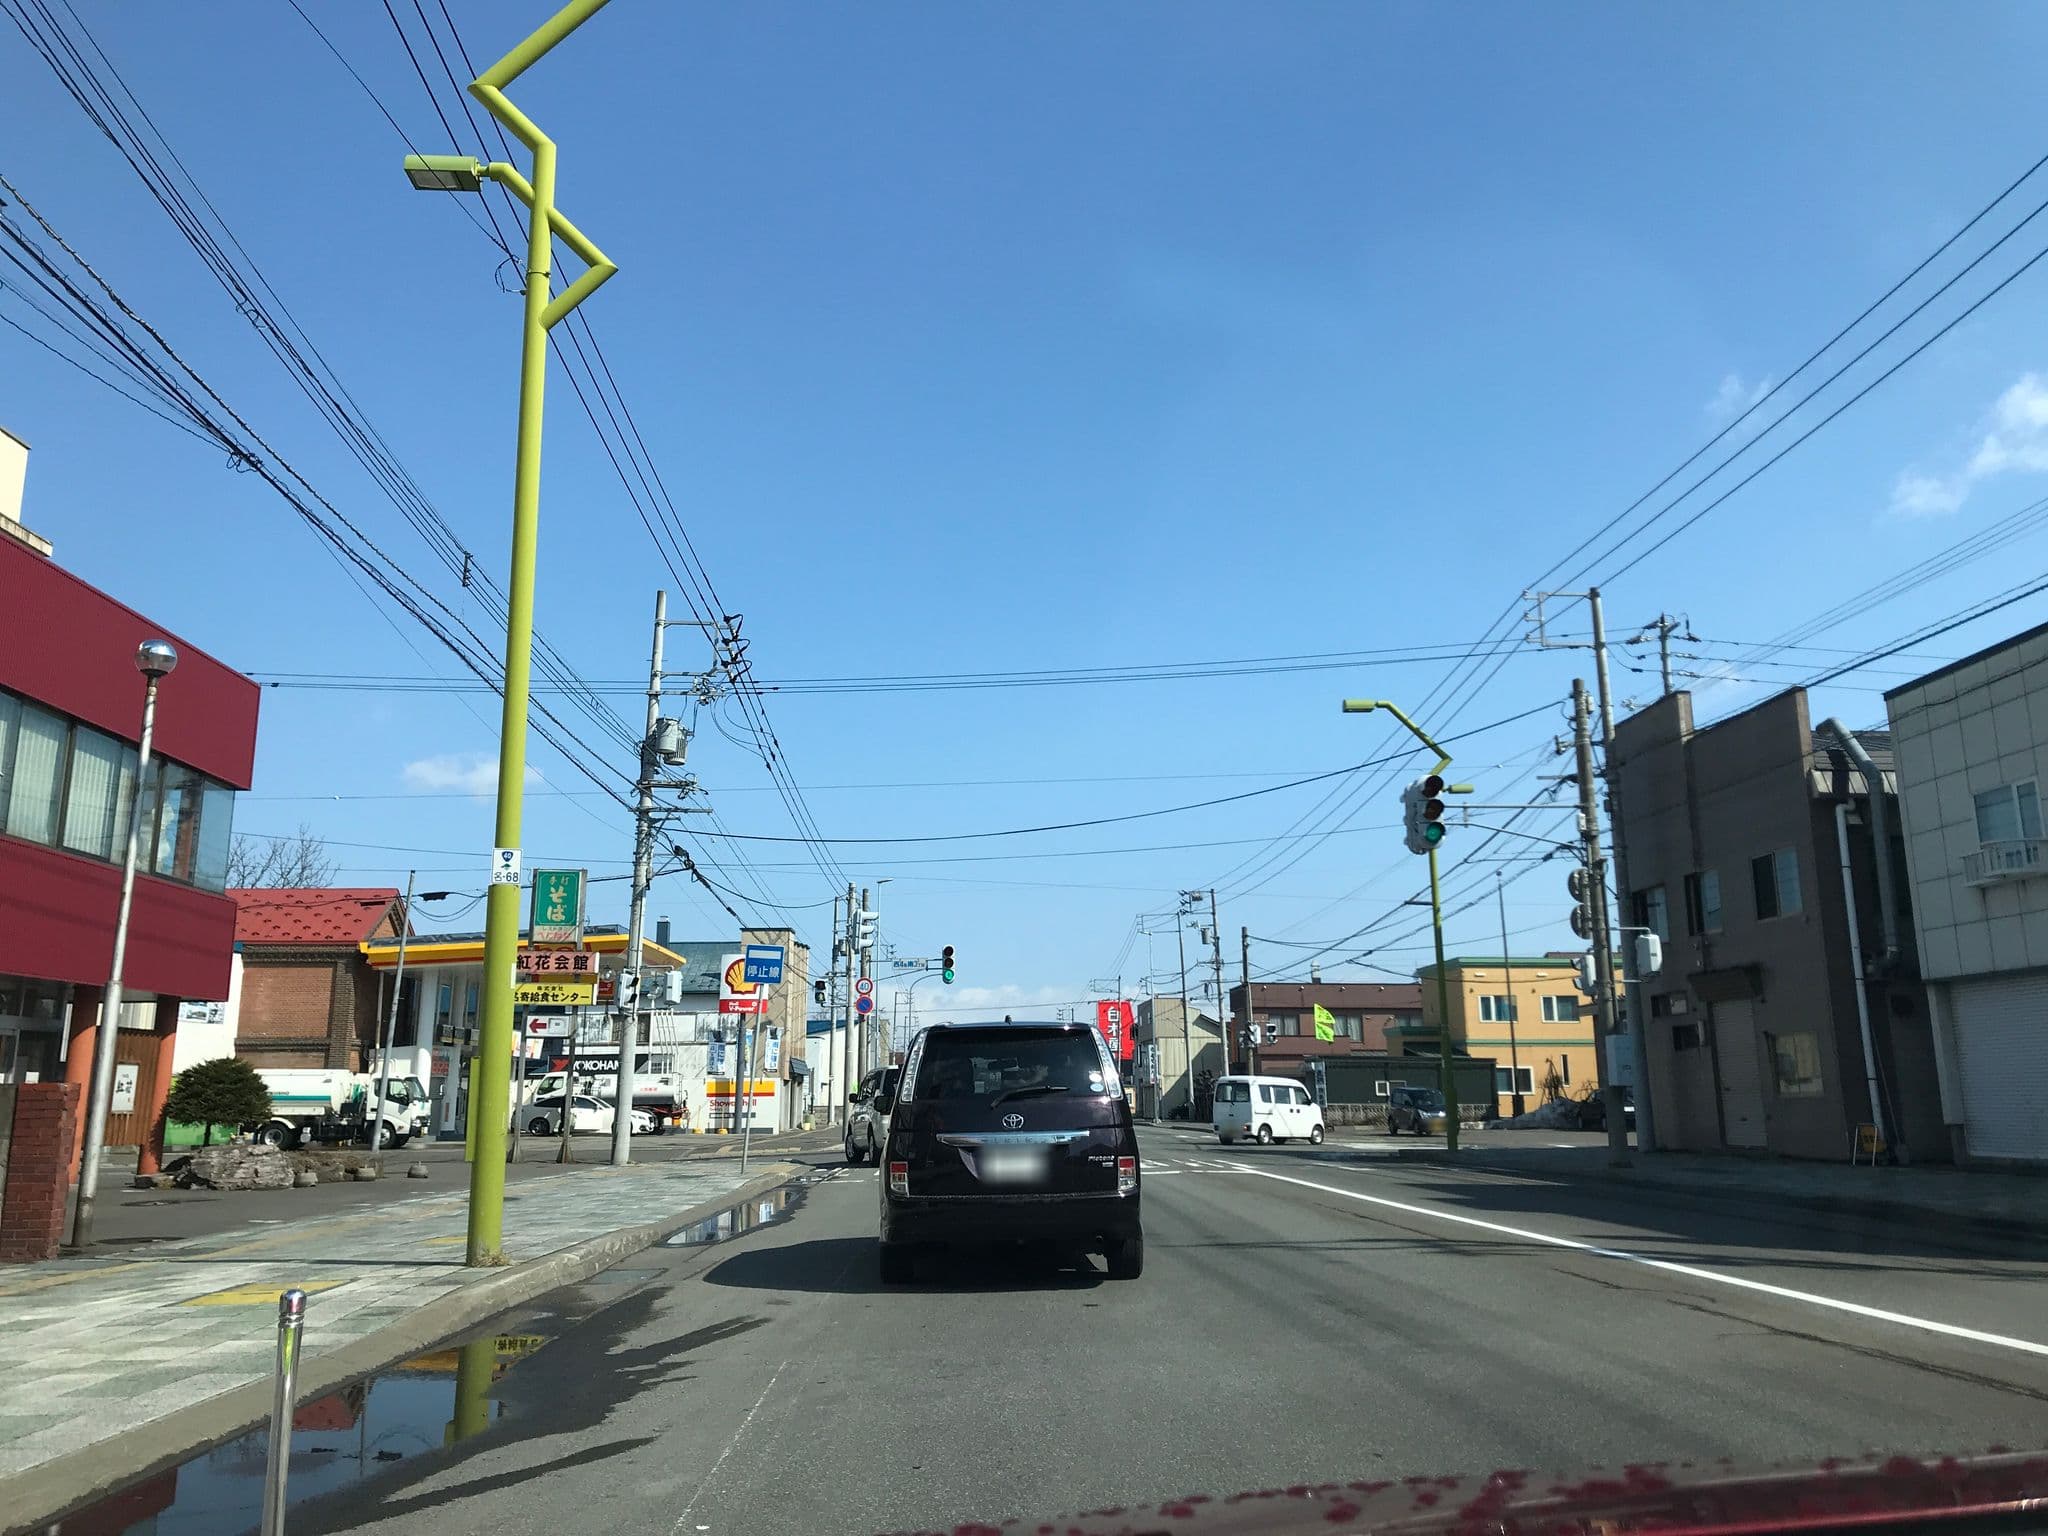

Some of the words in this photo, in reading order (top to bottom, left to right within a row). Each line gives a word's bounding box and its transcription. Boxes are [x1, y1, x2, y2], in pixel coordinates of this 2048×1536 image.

[546, 885, 567, 921] そば
[516, 954, 589, 970] 紅花会館
[747, 965, 780, 978] 停止線
[860, 982, 869, 991] 40
